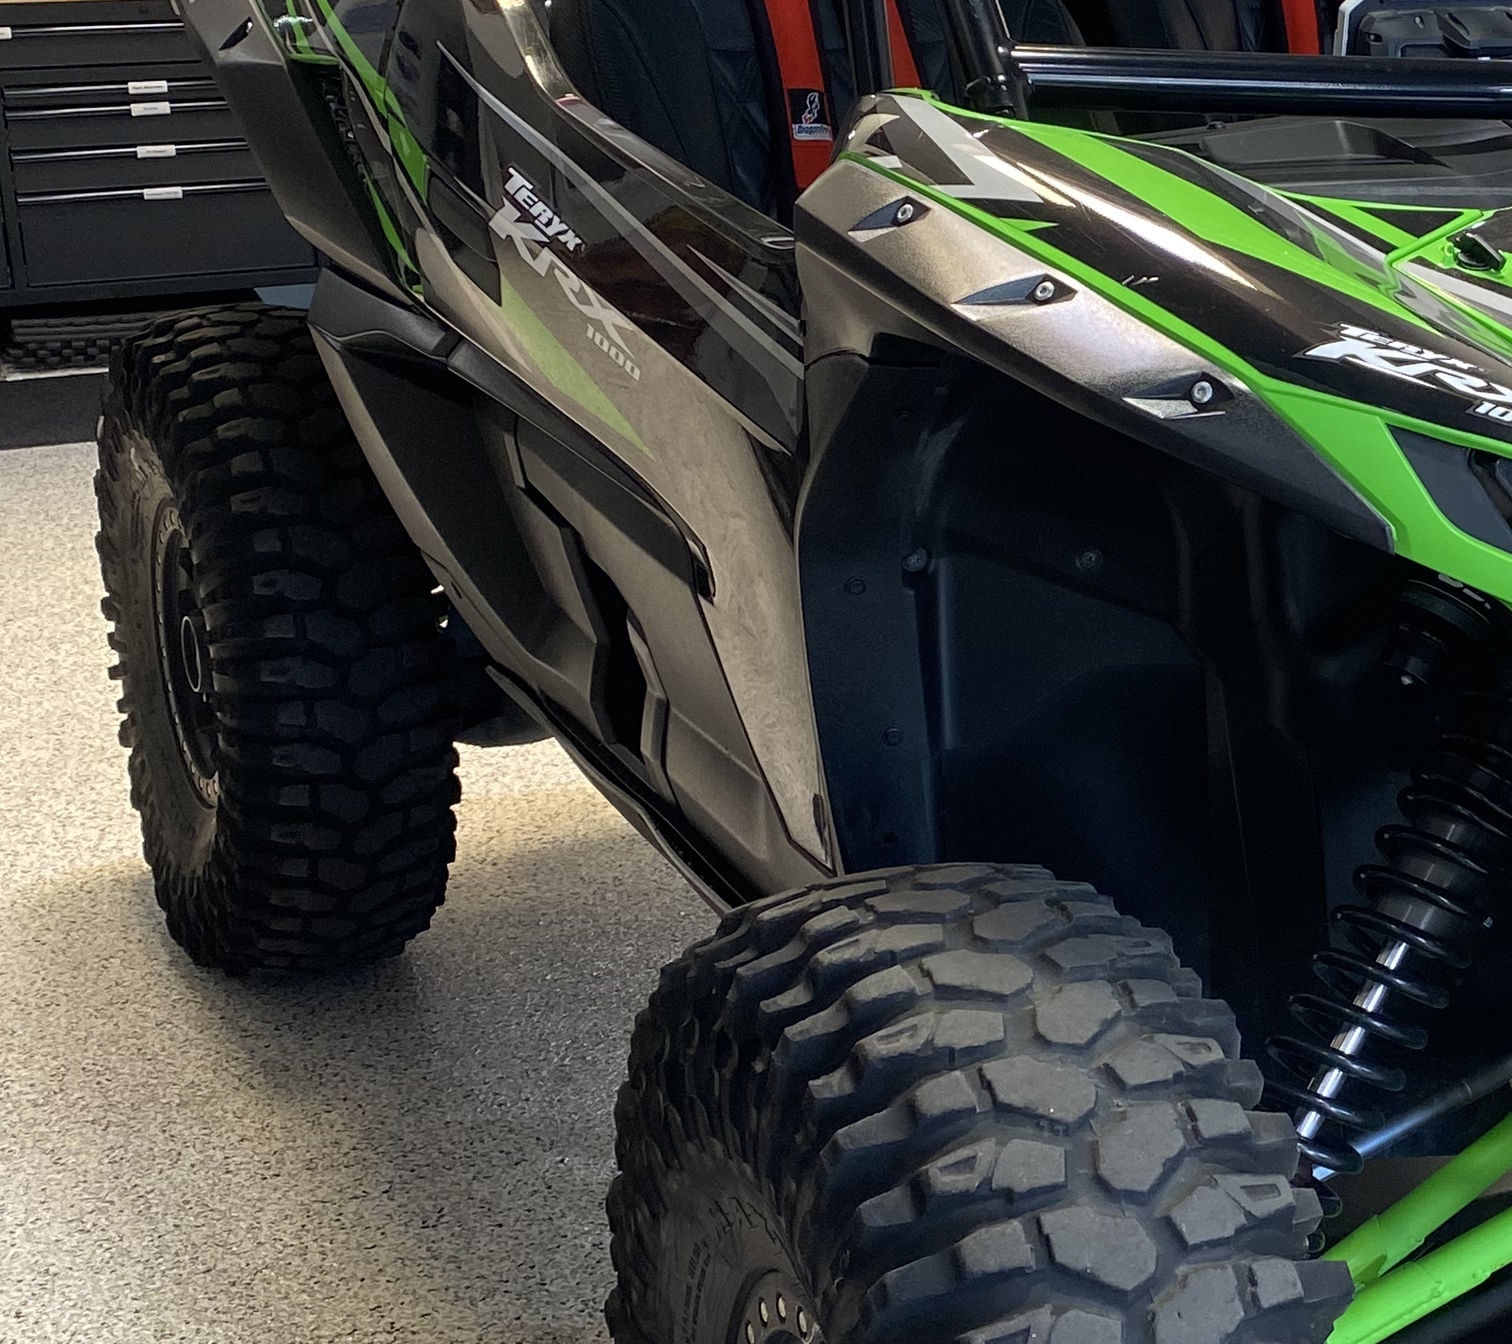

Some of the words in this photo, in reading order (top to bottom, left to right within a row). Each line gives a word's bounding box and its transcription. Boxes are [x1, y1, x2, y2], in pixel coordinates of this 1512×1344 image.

[504, 167, 582, 253] TERYX
[489, 196, 636, 360] KRX
[586, 322, 641, 381] 1000
